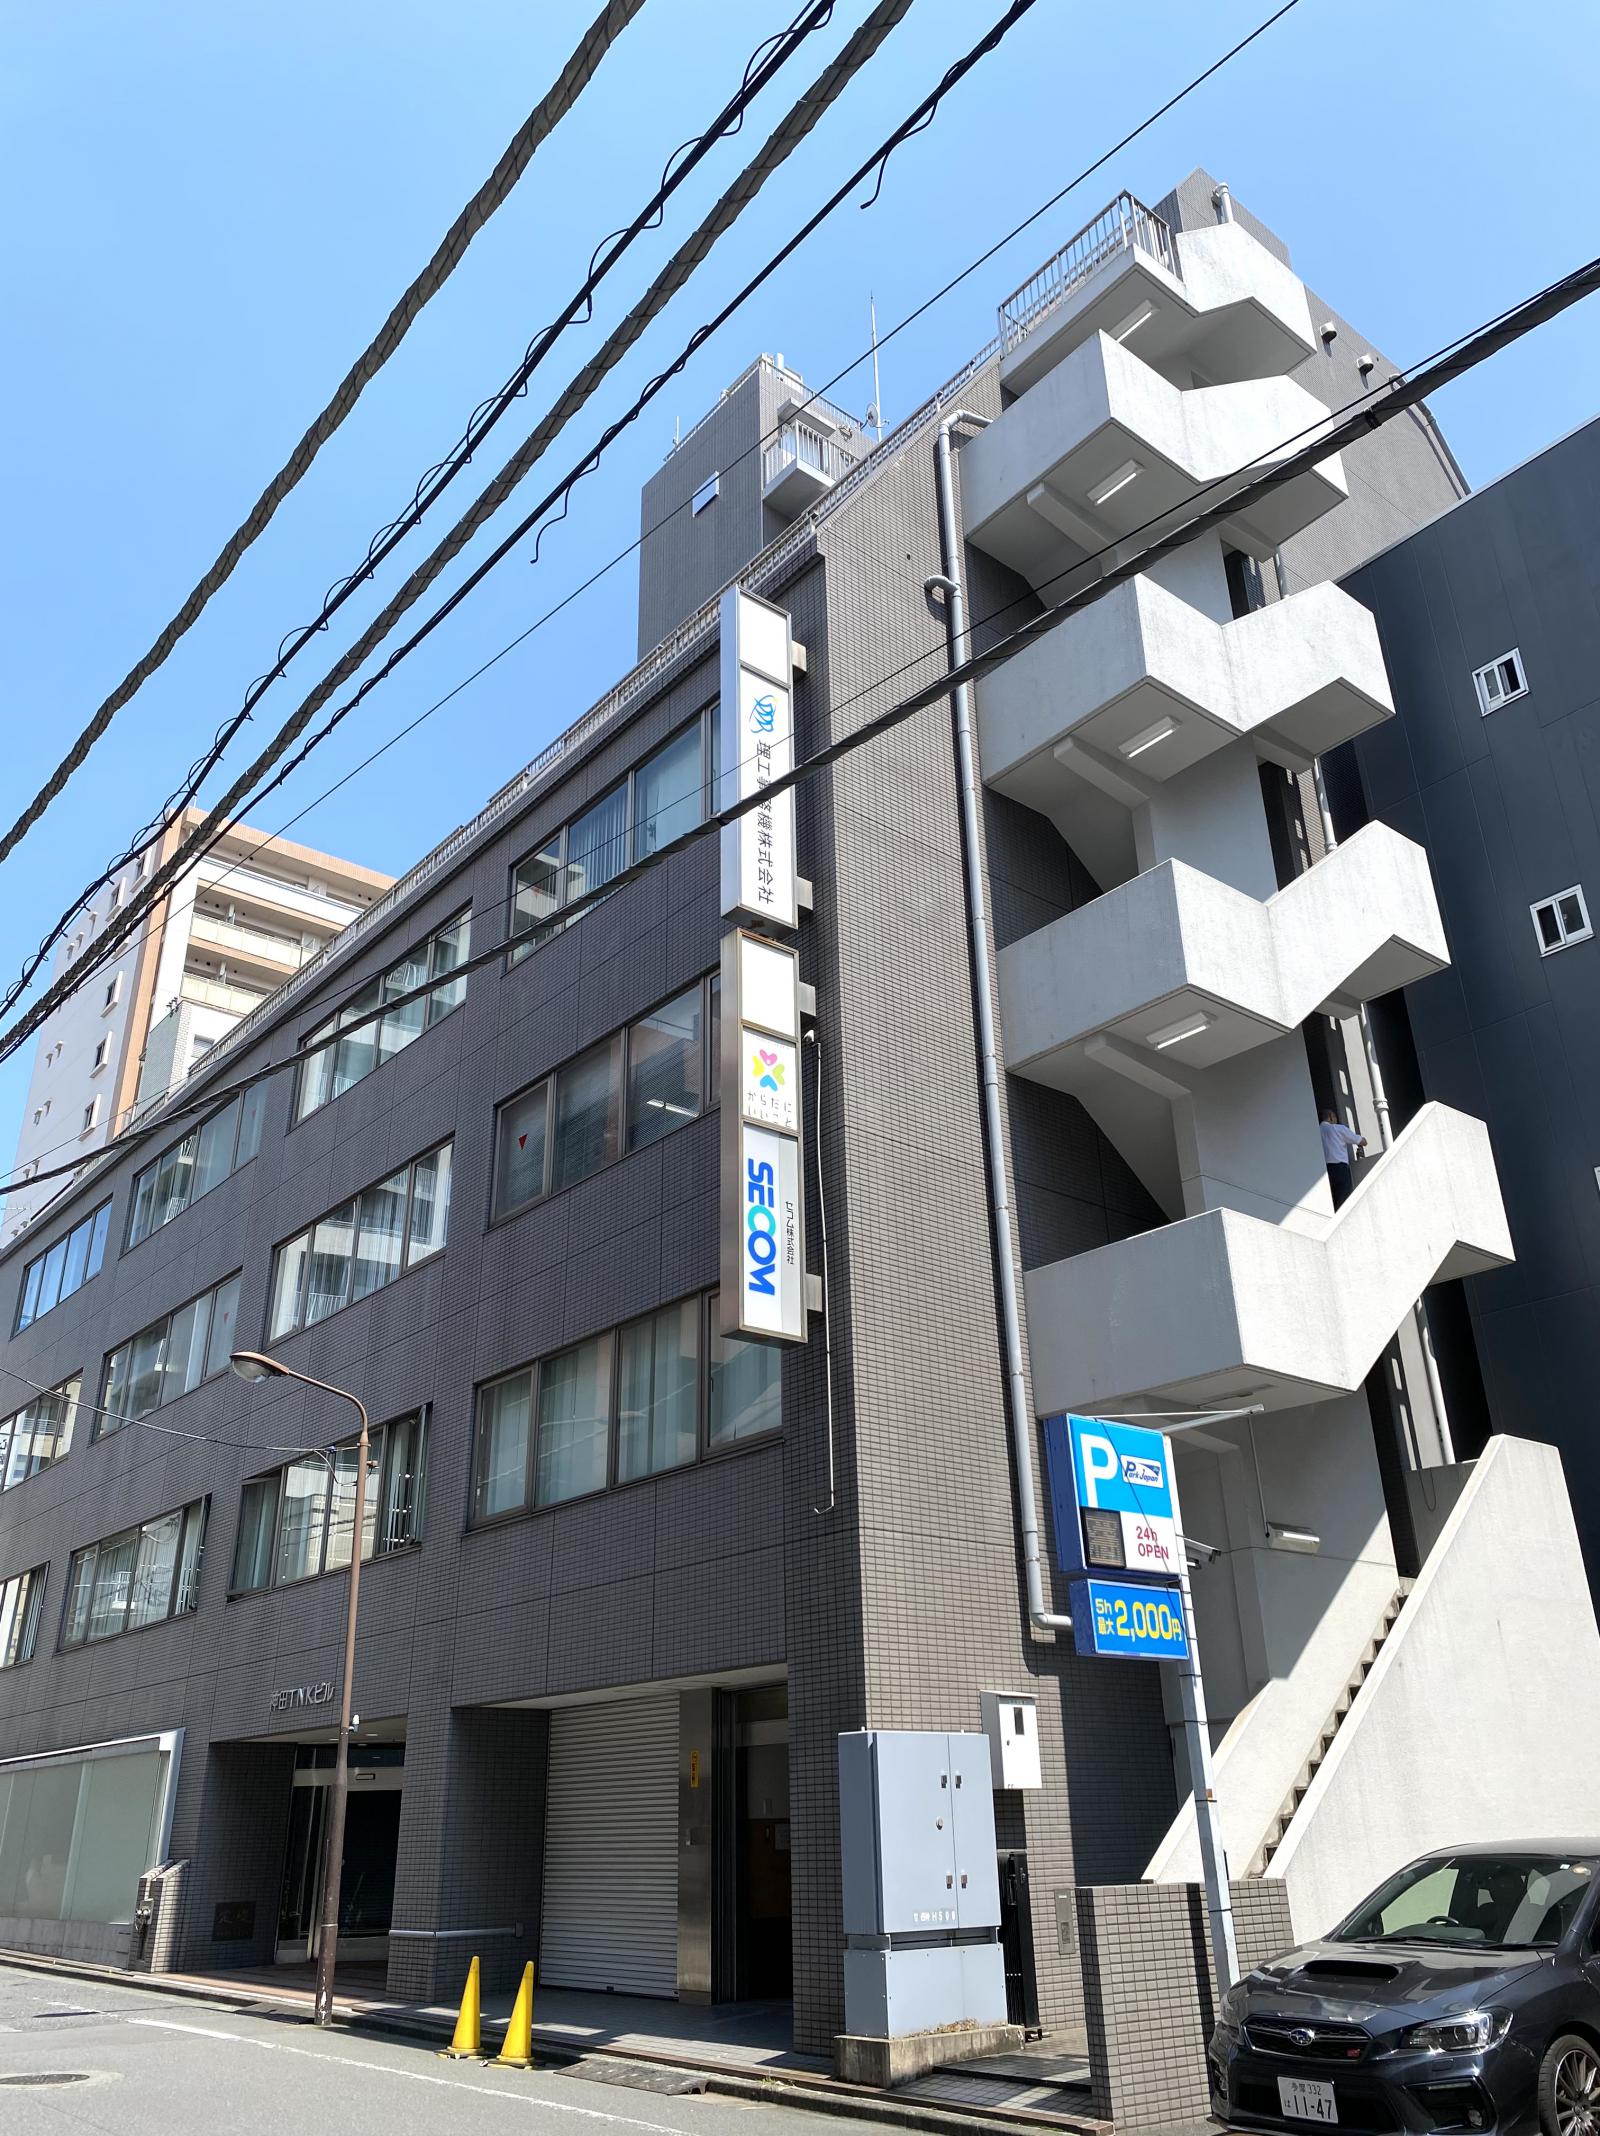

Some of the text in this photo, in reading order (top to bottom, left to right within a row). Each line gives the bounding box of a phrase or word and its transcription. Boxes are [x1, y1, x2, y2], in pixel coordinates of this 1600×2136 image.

[747, 1091, 792, 1113] からだに
[747, 1105, 792, 1128] いいこと
[747, 1158, 777, 1296] SECOM
[786, 1201, 795, 1265] セコム株式会社
[1080, 1433, 1119, 1508] P
[1125, 1460, 1159, 1483] Park Japan
[1135, 1525, 1158, 1541] 24h
[1137, 1543, 1170, 1560] OPEN
[1095, 1598, 1113, 1615] 5h
[1098, 1616, 1115, 1636] 最大
[1115, 1599, 1183, 1642] 2,000円
[1307, 2084, 1322, 2096] 332
[1293, 2095, 1332, 2120] 11-47
